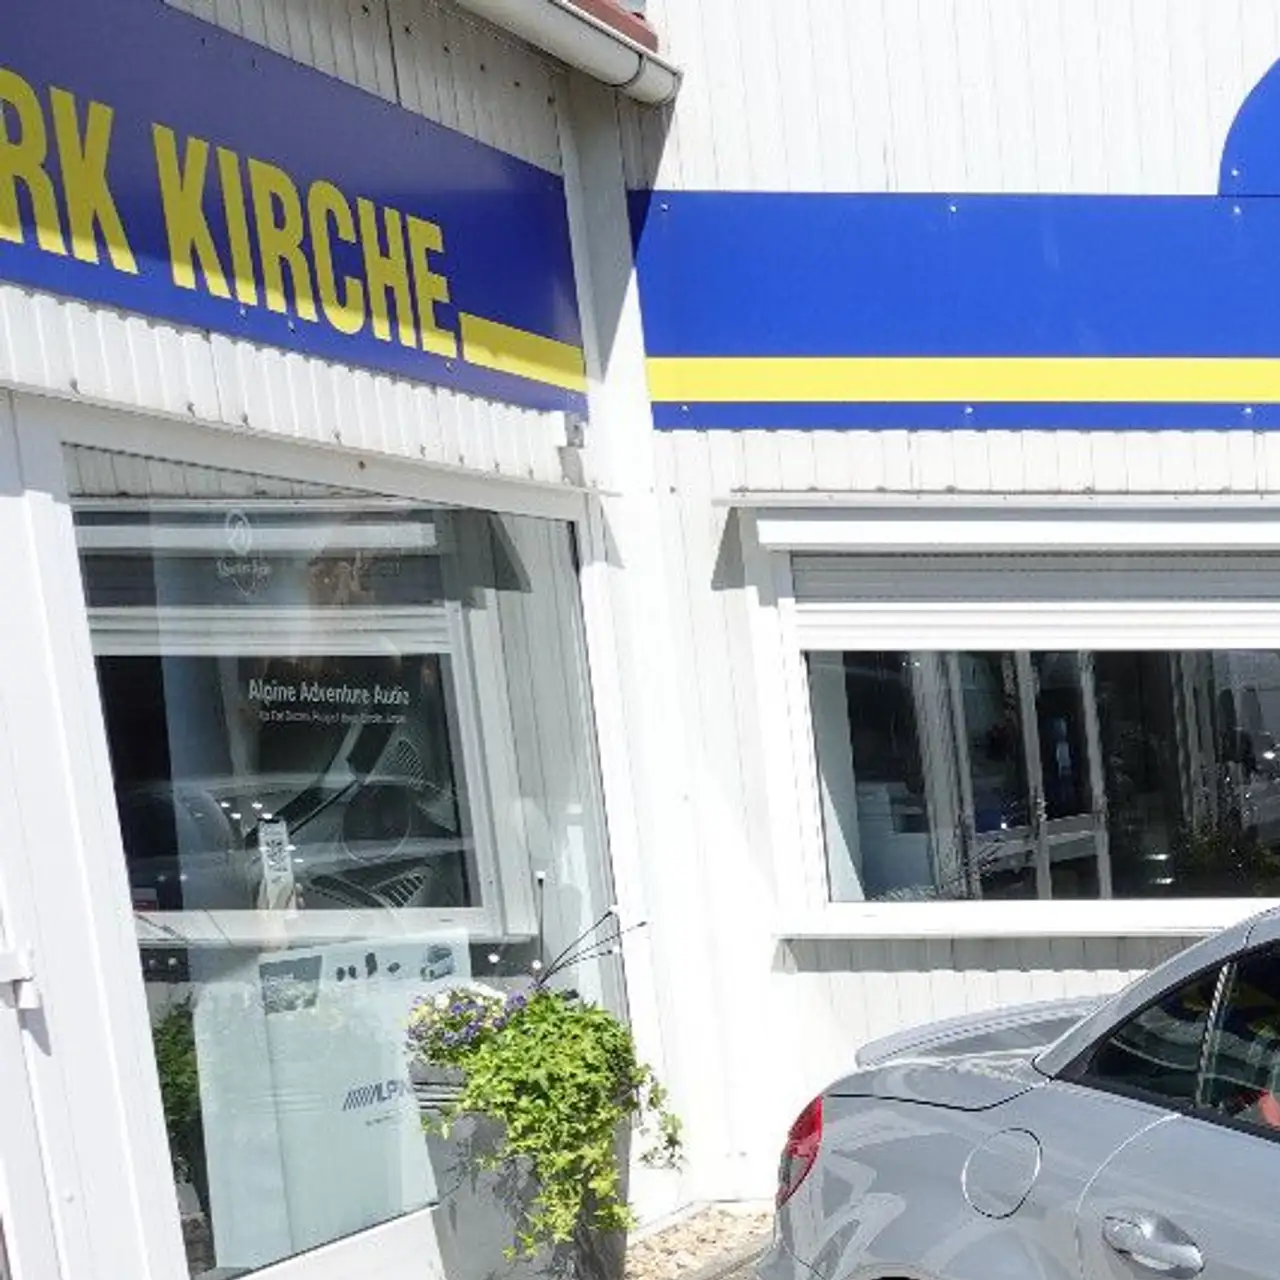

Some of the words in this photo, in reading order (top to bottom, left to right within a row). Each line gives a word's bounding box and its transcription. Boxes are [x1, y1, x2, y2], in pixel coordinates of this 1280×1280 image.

[152, 122, 459, 359] KIRCHE
[249, 678, 297, 708] Alpine
[300, 681, 370, 705] Adventure
